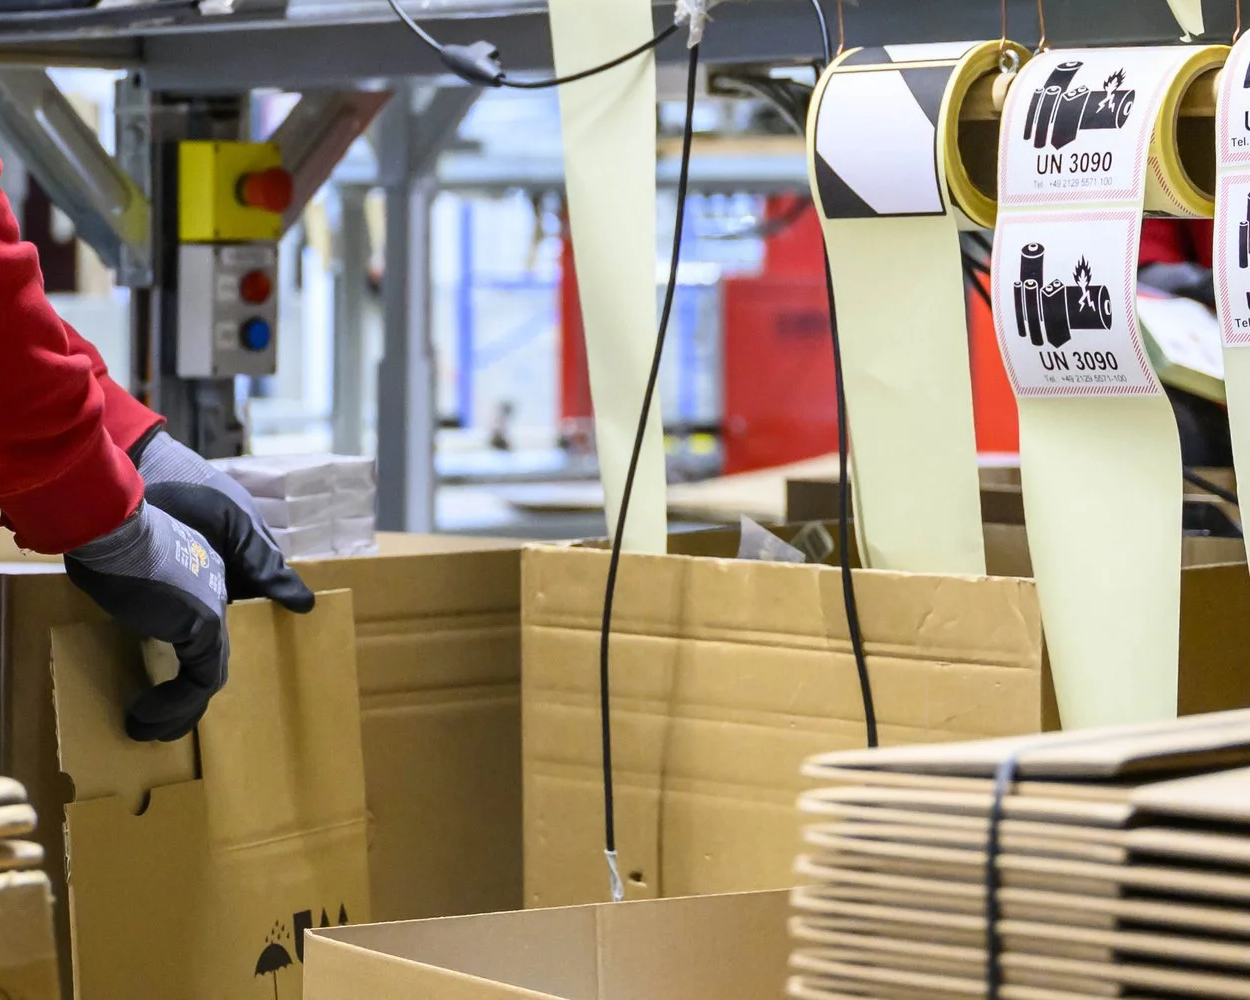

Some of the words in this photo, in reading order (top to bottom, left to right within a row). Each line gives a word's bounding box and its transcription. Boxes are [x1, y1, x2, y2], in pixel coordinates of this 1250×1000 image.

[1037, 153, 1063, 175] UN
[1069, 151, 1113, 174] 3090
[1039, 351, 1070, 371] UN
[1072, 351, 1119, 371] 3090
